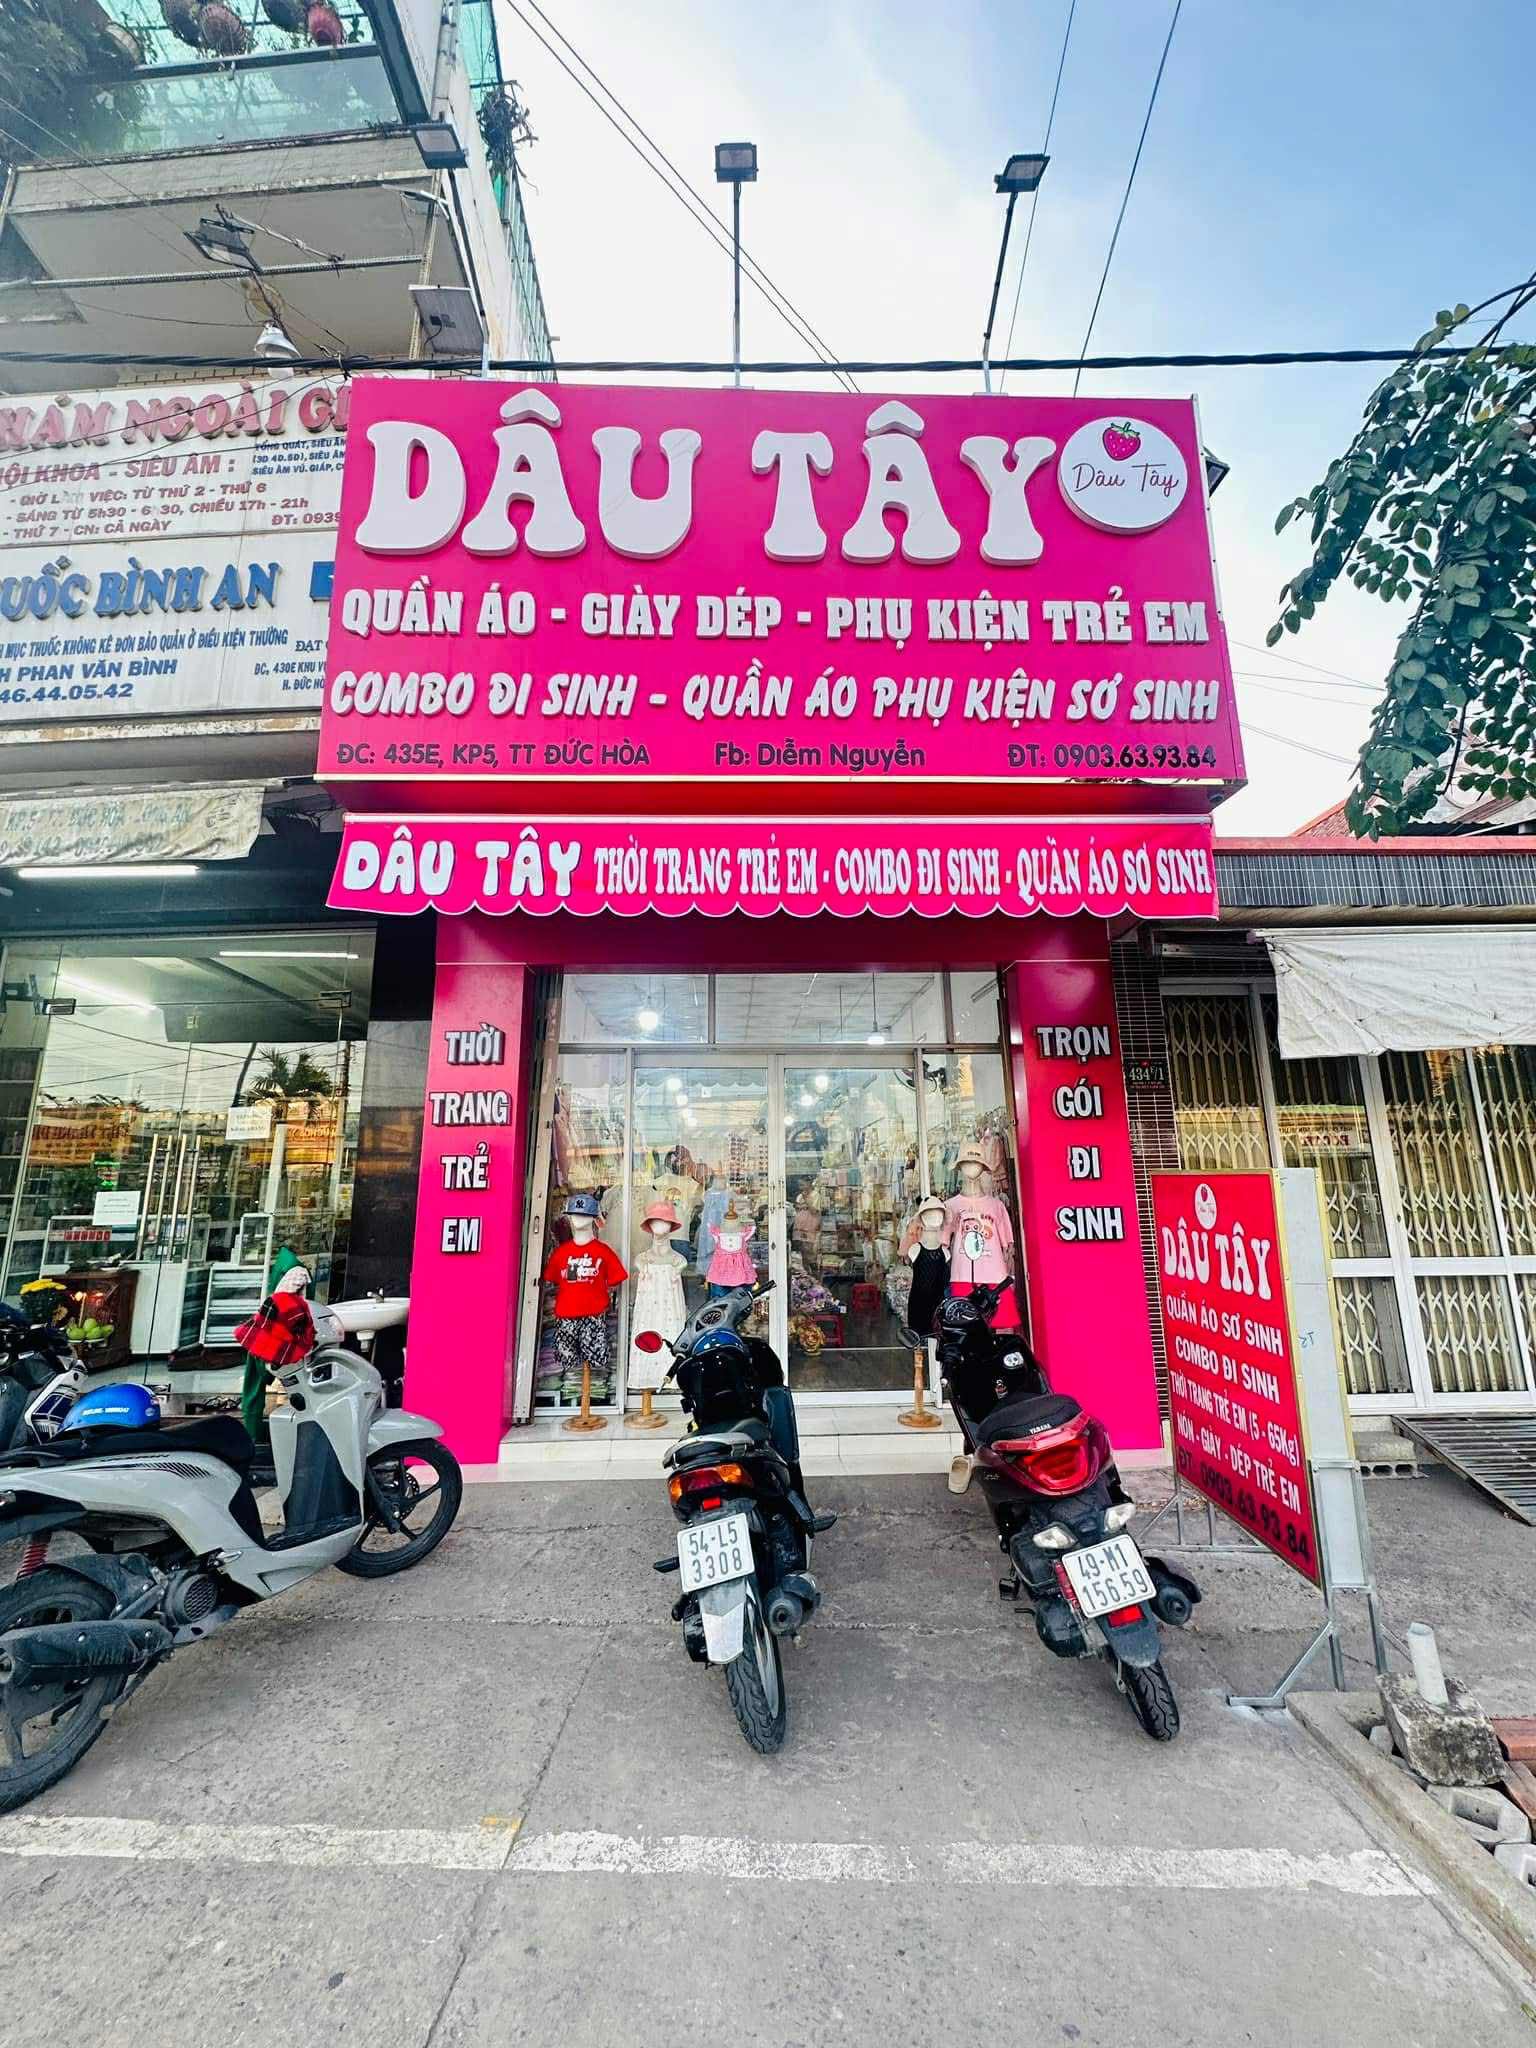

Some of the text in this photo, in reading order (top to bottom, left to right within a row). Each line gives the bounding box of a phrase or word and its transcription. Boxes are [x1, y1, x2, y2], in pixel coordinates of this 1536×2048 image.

[122, 378, 289, 445] NGOÀI
[0, 453, 221, 489] ỘI KHOA SIÊU ÂM
[194, 486, 206, 496] 2
[256, 482, 267, 493] 6
[355, 388, 1057, 566] DÂU TÂY
[1072, 462, 1179, 498] Dâu Tây
[16, 507, 58, 522] SÁNG
[88, 506, 127, 519] 5h30
[239, 499, 266, 511] 17h
[281, 497, 309, 509] 21h
[50, 526, 59, 537] 7
[73, 524, 100, 536] CN:
[129, 517, 172, 533] NGÀY
[94, 556, 209, 618] BÌNH
[210, 562, 281, 611] AN
[341, 574, 1210, 651] QUẦN ÁO GIÀY DÉP PHỤ KIỆN TRẺ EM
[17, 663, 74, 682] PHAN
[82, 658, 123, 679] VĂN
[128, 656, 178, 677] BÌNH
[330, 657, 1220, 728] COMBO ĐI SINH QUẦN ÁO PHỤ KIỆN SƠ SINH
[336, 737, 651, 768] ĐC: 435E, KP5, TT ĐỨC HÒA
[714, 737, 926, 772] Fb: Diễm Nguyễn
[1007, 743, 1217, 769] ĐT: 0903.63.93.84
[342, 825, 456, 896] DÂU
[475, 825, 582, 897] TÂY
[593, 833, 648, 895] THỜI
[652, 847, 733, 895] TRANG
[736, 832, 781, 895] TRẺ
[785, 847, 818, 895] EM
[834, 847, 911, 896] COMBO
[917, 847, 941, 896] ĐI
[947, 847, 1001, 896] SINH
[1016, 835, 1081, 906] QUẦN
[1156, 847, 1213, 895] SINH
[445, 1022, 504, 1064] THỜI
[1036, 1026, 1111, 1062] TRỌN
[429, 1091, 511, 1126] TRANG
[1054, 1078, 1103, 1118] GÓI
[441, 1142, 489, 1189] TRẺ
[1068, 1146, 1102, 1179] ĐI
[441, 1216, 482, 1254] EM
[1057, 1205, 1124, 1240] SINH
[1161, 1216, 1272, 1301] DÂU TÂY
[1166, 1292, 1198, 1326] QUẦN
[1200, 1299, 1219, 1333] ÁO
[1221, 1311, 1241, 1341] SƠ
[1244, 1319, 1284, 1358] SINH
[1175, 1335, 1280, 1405] COMBO ĐI SINH
[1187, 1378, 1214, 1415] TRANG
[1213, 1388, 1232, 1425] TRẺ
[1231, 1401, 1248, 1434] EM
[1267, 1420, 1300, 1468] 65Kg)
[1176, 1408, 1302, 1516] NÓN GIÀY DÉP TRẺ EM
[689, 1521, 738, 1557] 54-L5
[691, 1547, 742, 1583] 3308
[1083, 1568, 1148, 1610] 156.59
